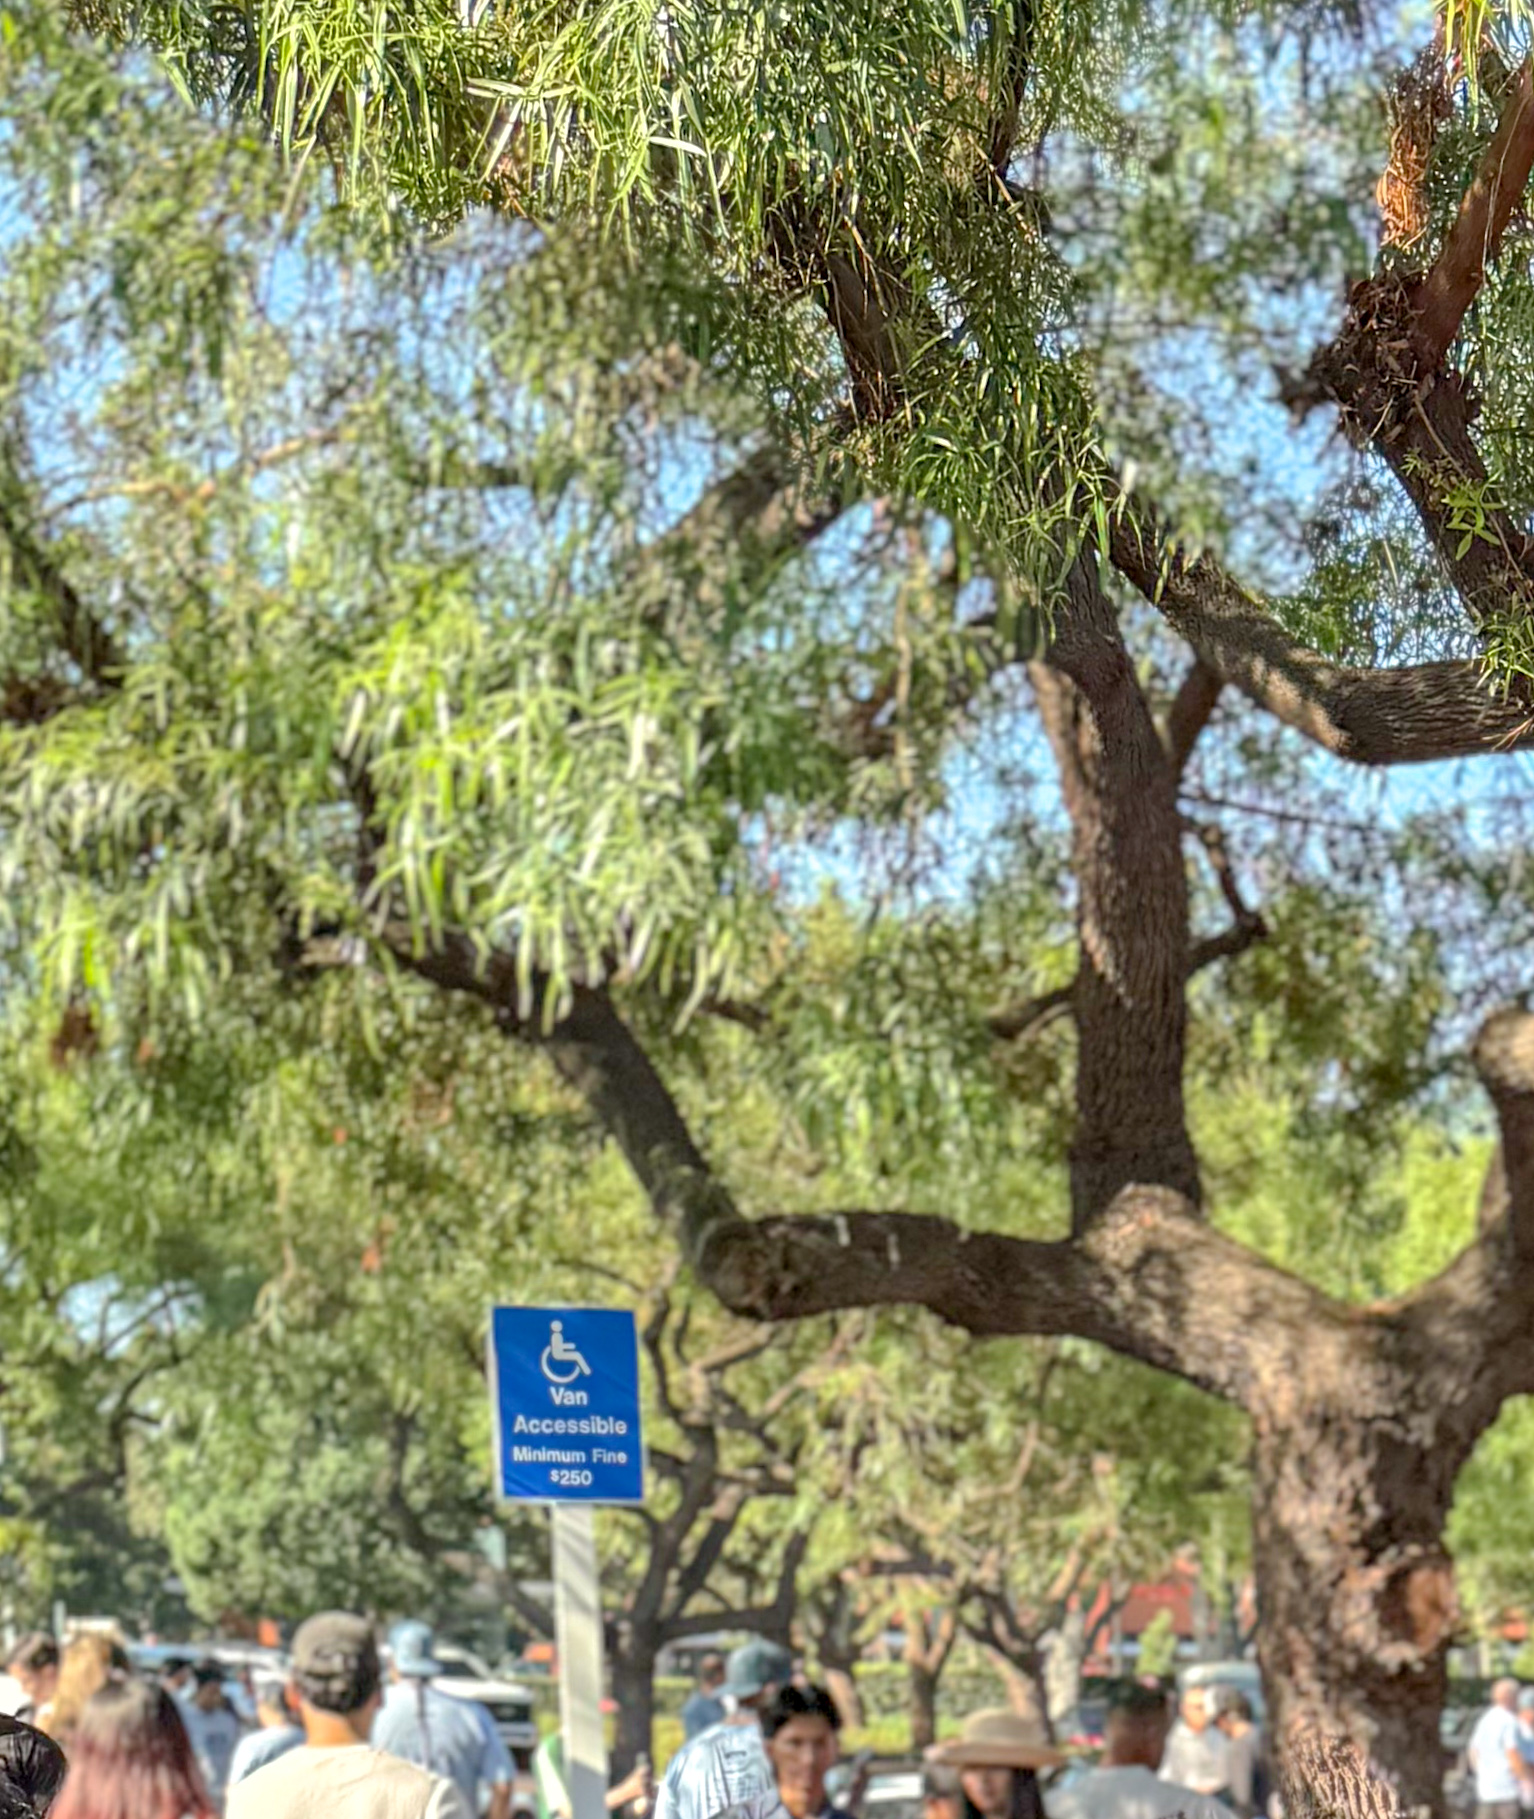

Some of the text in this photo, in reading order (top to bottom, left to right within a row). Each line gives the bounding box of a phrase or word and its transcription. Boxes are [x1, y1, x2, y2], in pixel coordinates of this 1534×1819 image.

[550, 1386, 588, 1405] Van
[513, 1414, 628, 1434] Accessible
[513, 1445, 628, 1464] Minimum Fine
[550, 1470, 593, 1486] $250
